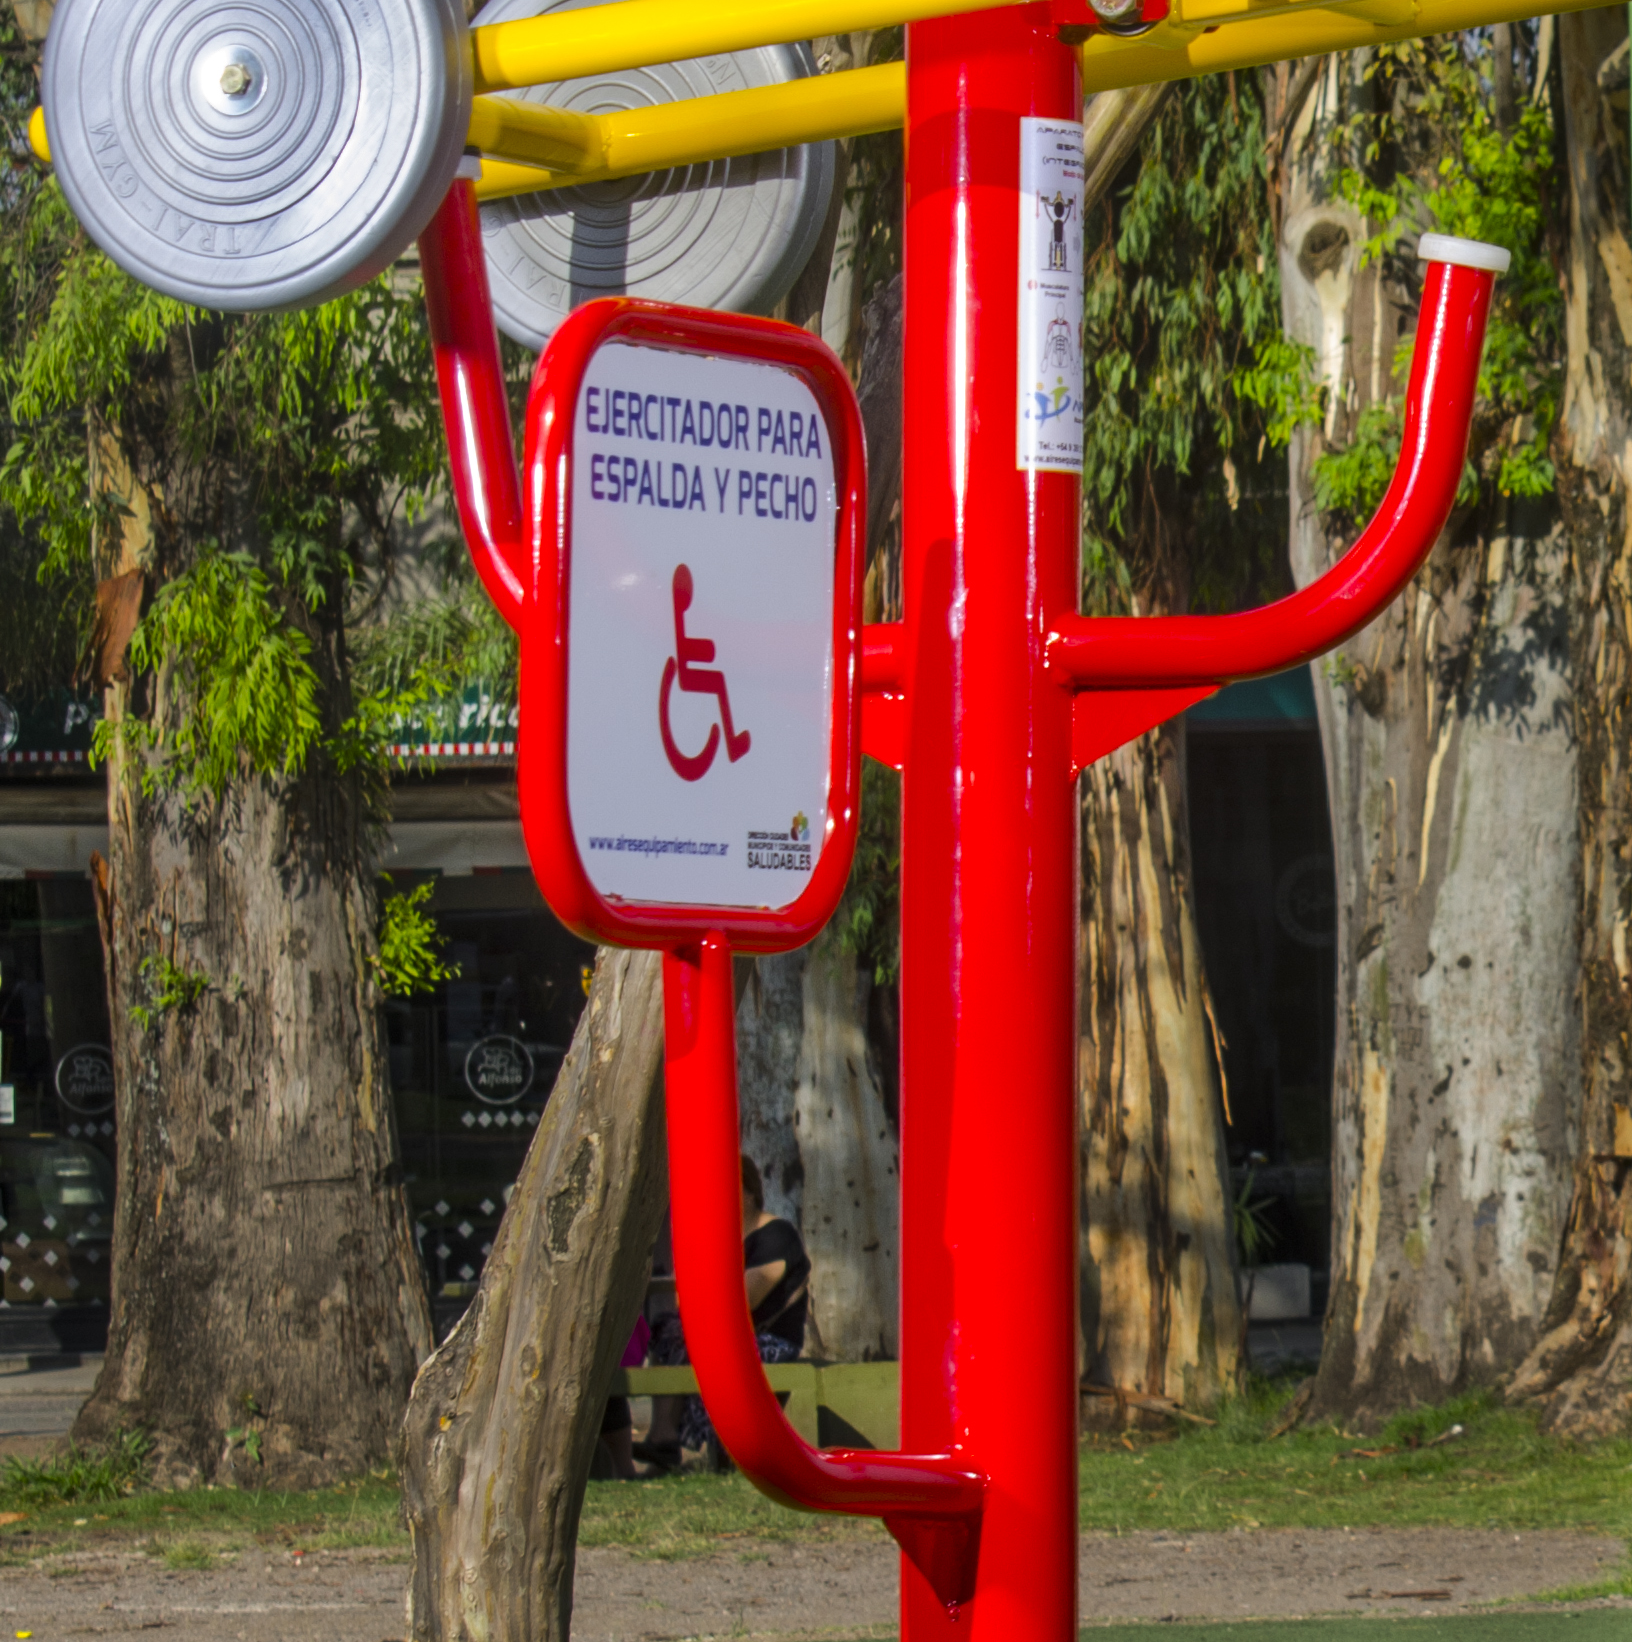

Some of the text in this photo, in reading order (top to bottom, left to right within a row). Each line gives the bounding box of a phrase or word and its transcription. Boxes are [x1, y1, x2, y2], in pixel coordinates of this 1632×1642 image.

[586, 386, 822, 459] EJERCITADOR PARA
[591, 453, 817, 523] ESPALDA Y PECHO
[589, 834, 729, 858] www.airesequipamiento.com.ar
[748, 851, 811, 871] SALUDABLES
